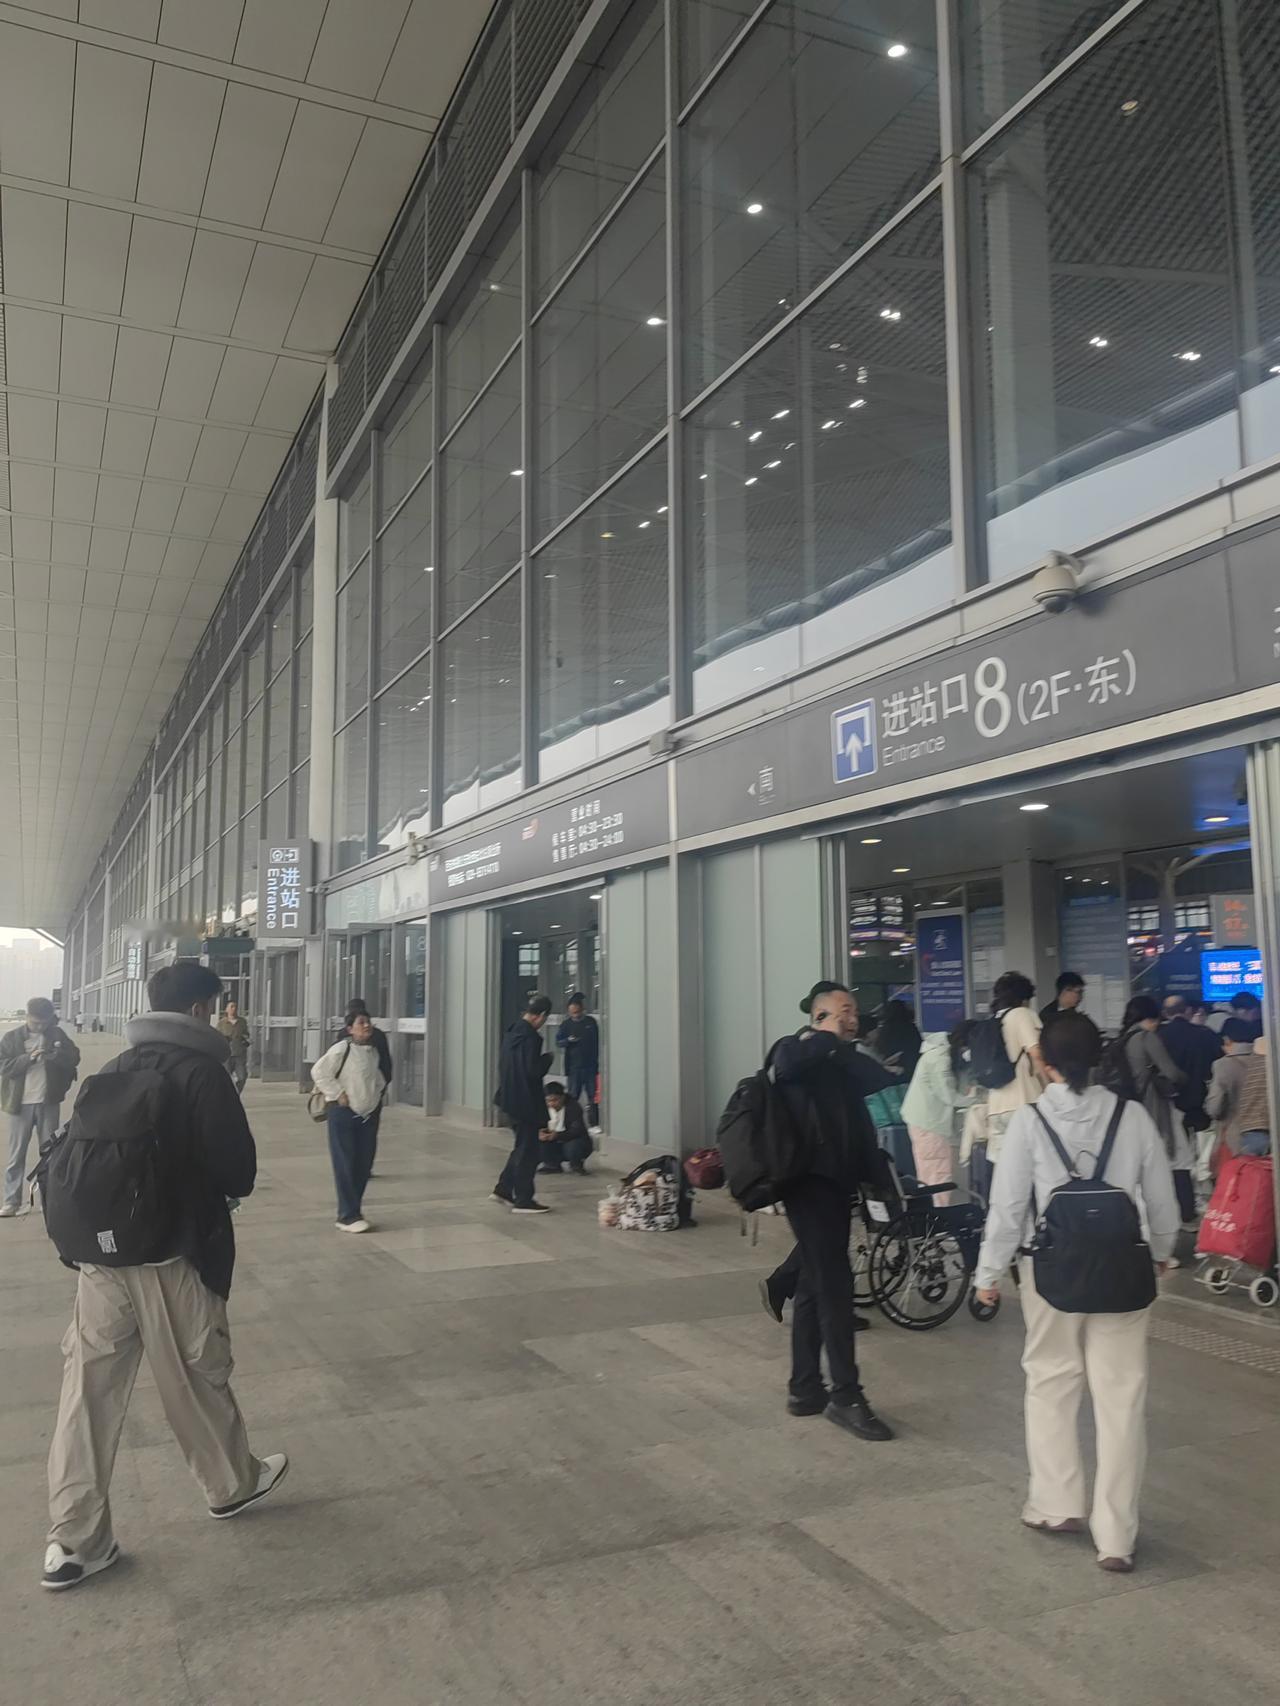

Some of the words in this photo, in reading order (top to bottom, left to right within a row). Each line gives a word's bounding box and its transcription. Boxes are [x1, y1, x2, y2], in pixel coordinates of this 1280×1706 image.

[883, 736, 946, 767] Entrance
[266, 868, 280, 929] Entrance
[280, 867, 301, 929] 进站口
